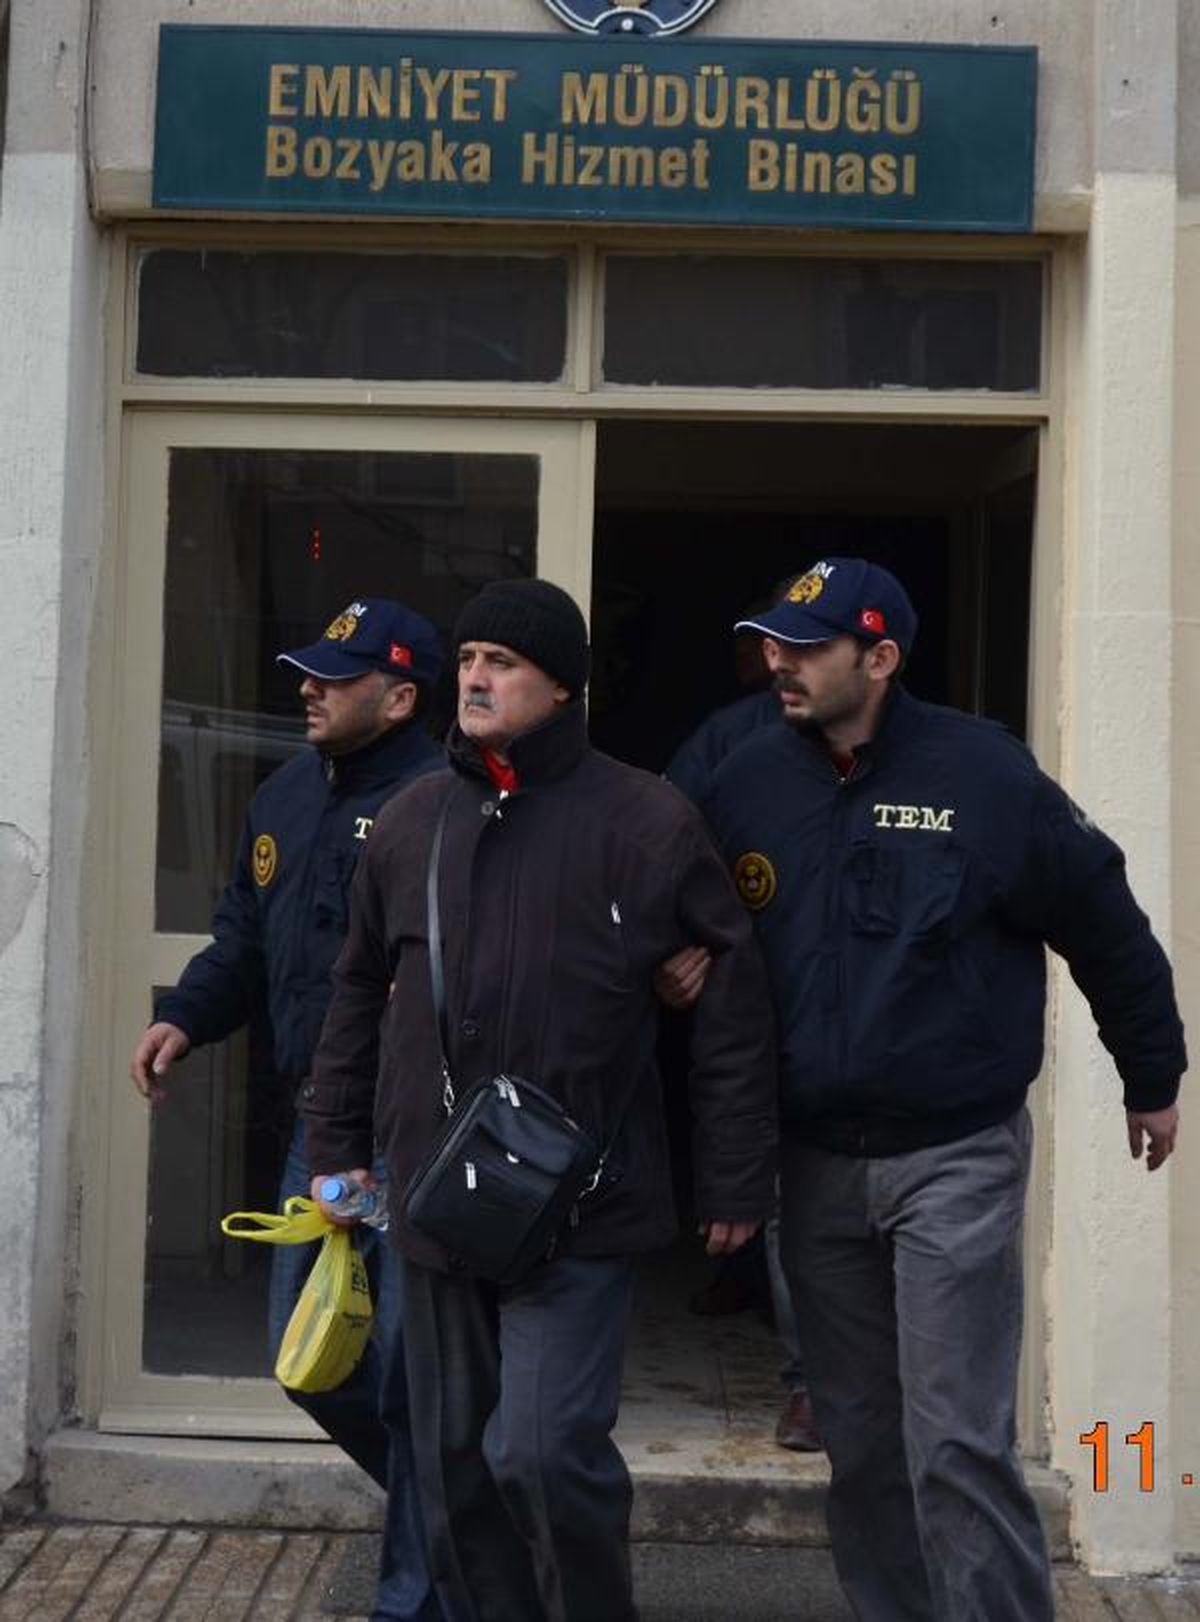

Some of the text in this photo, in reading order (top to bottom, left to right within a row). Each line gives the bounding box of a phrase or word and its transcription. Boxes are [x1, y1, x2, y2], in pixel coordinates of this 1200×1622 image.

[268, 58, 921, 134] EMNİYET MÜDÜRLÜĞÜ
[265, 126, 916, 195] Bozyaka Hizmet Binası
[873, 803, 955, 832] TEM
